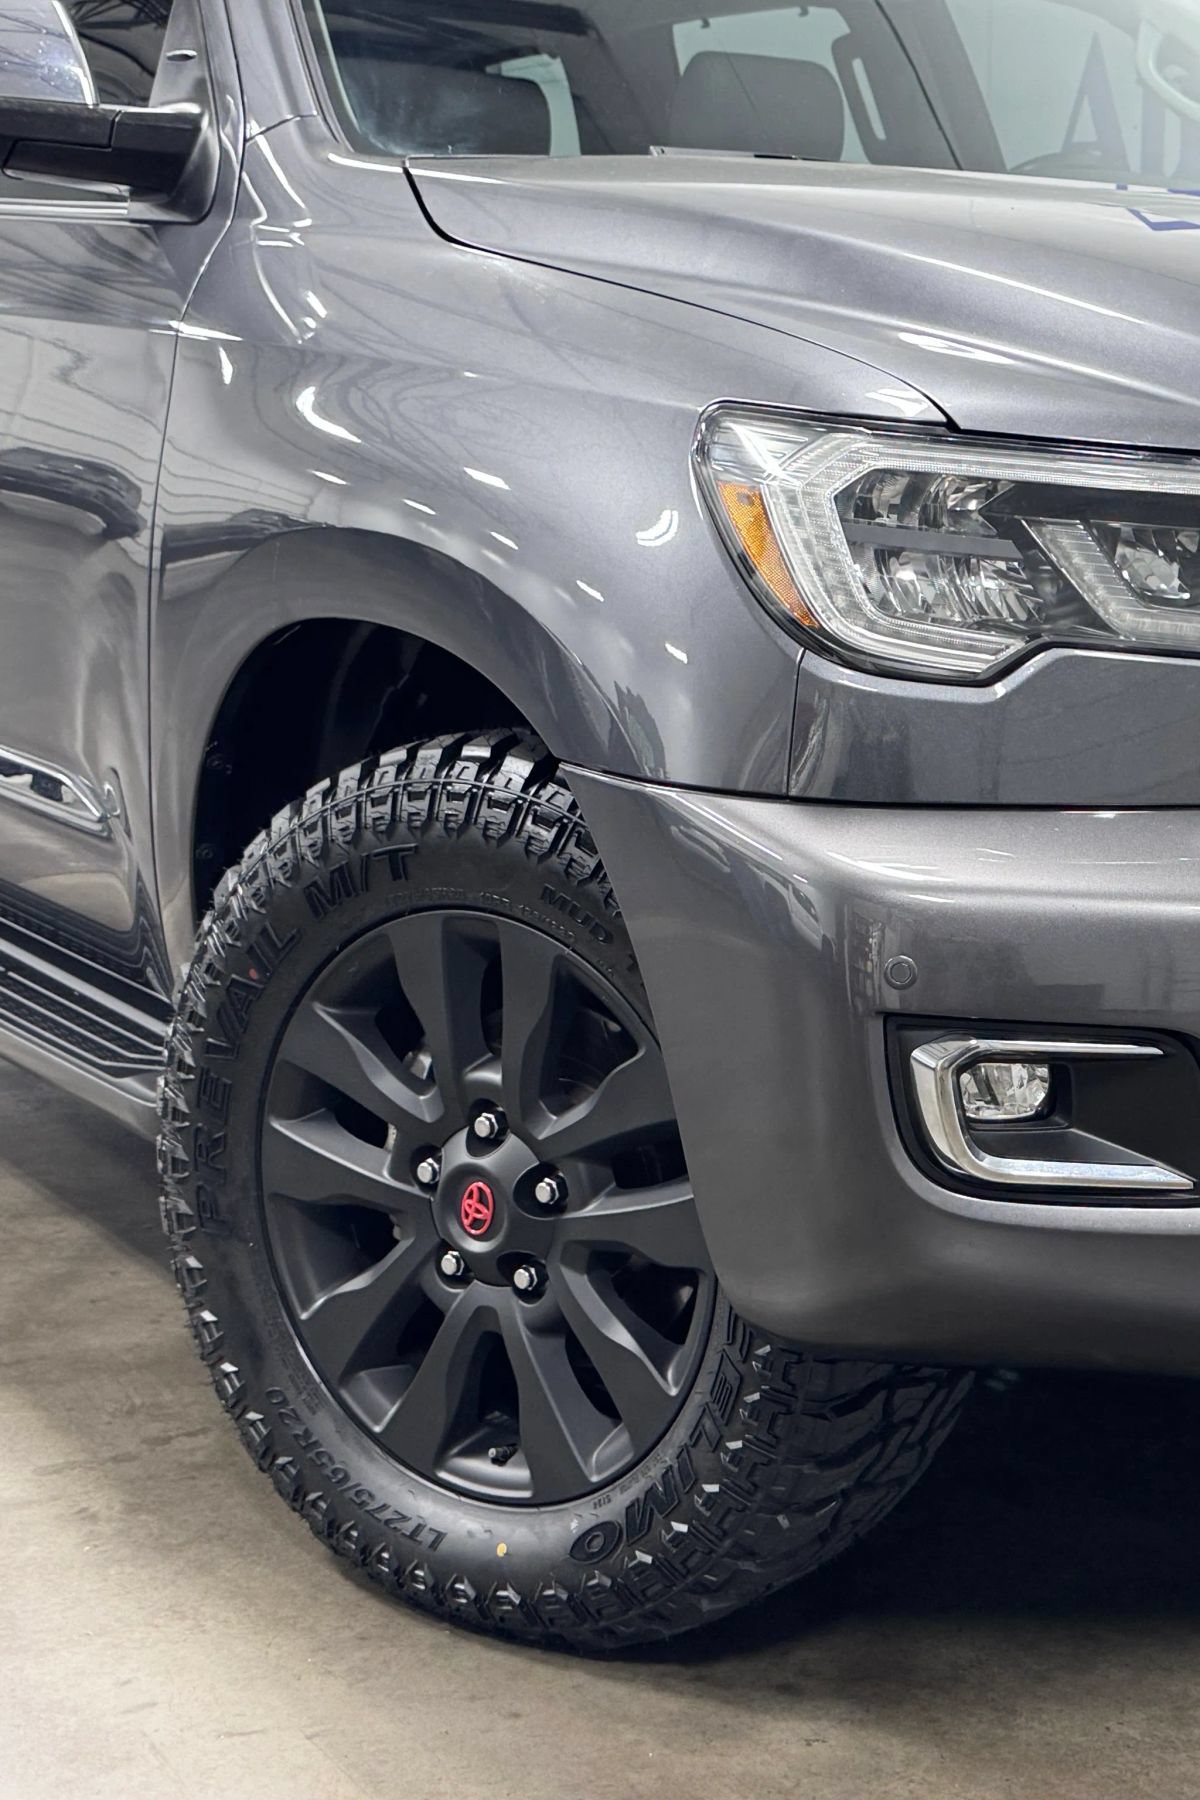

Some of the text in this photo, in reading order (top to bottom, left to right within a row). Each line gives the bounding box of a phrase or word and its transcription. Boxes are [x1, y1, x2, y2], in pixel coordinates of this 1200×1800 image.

[538, 882, 615, 945] MUD
[193, 921, 303, 1237] PREVAIL
[303, 843, 418, 922] M/T
[263, 1386, 446, 1554] LT275/65R20
